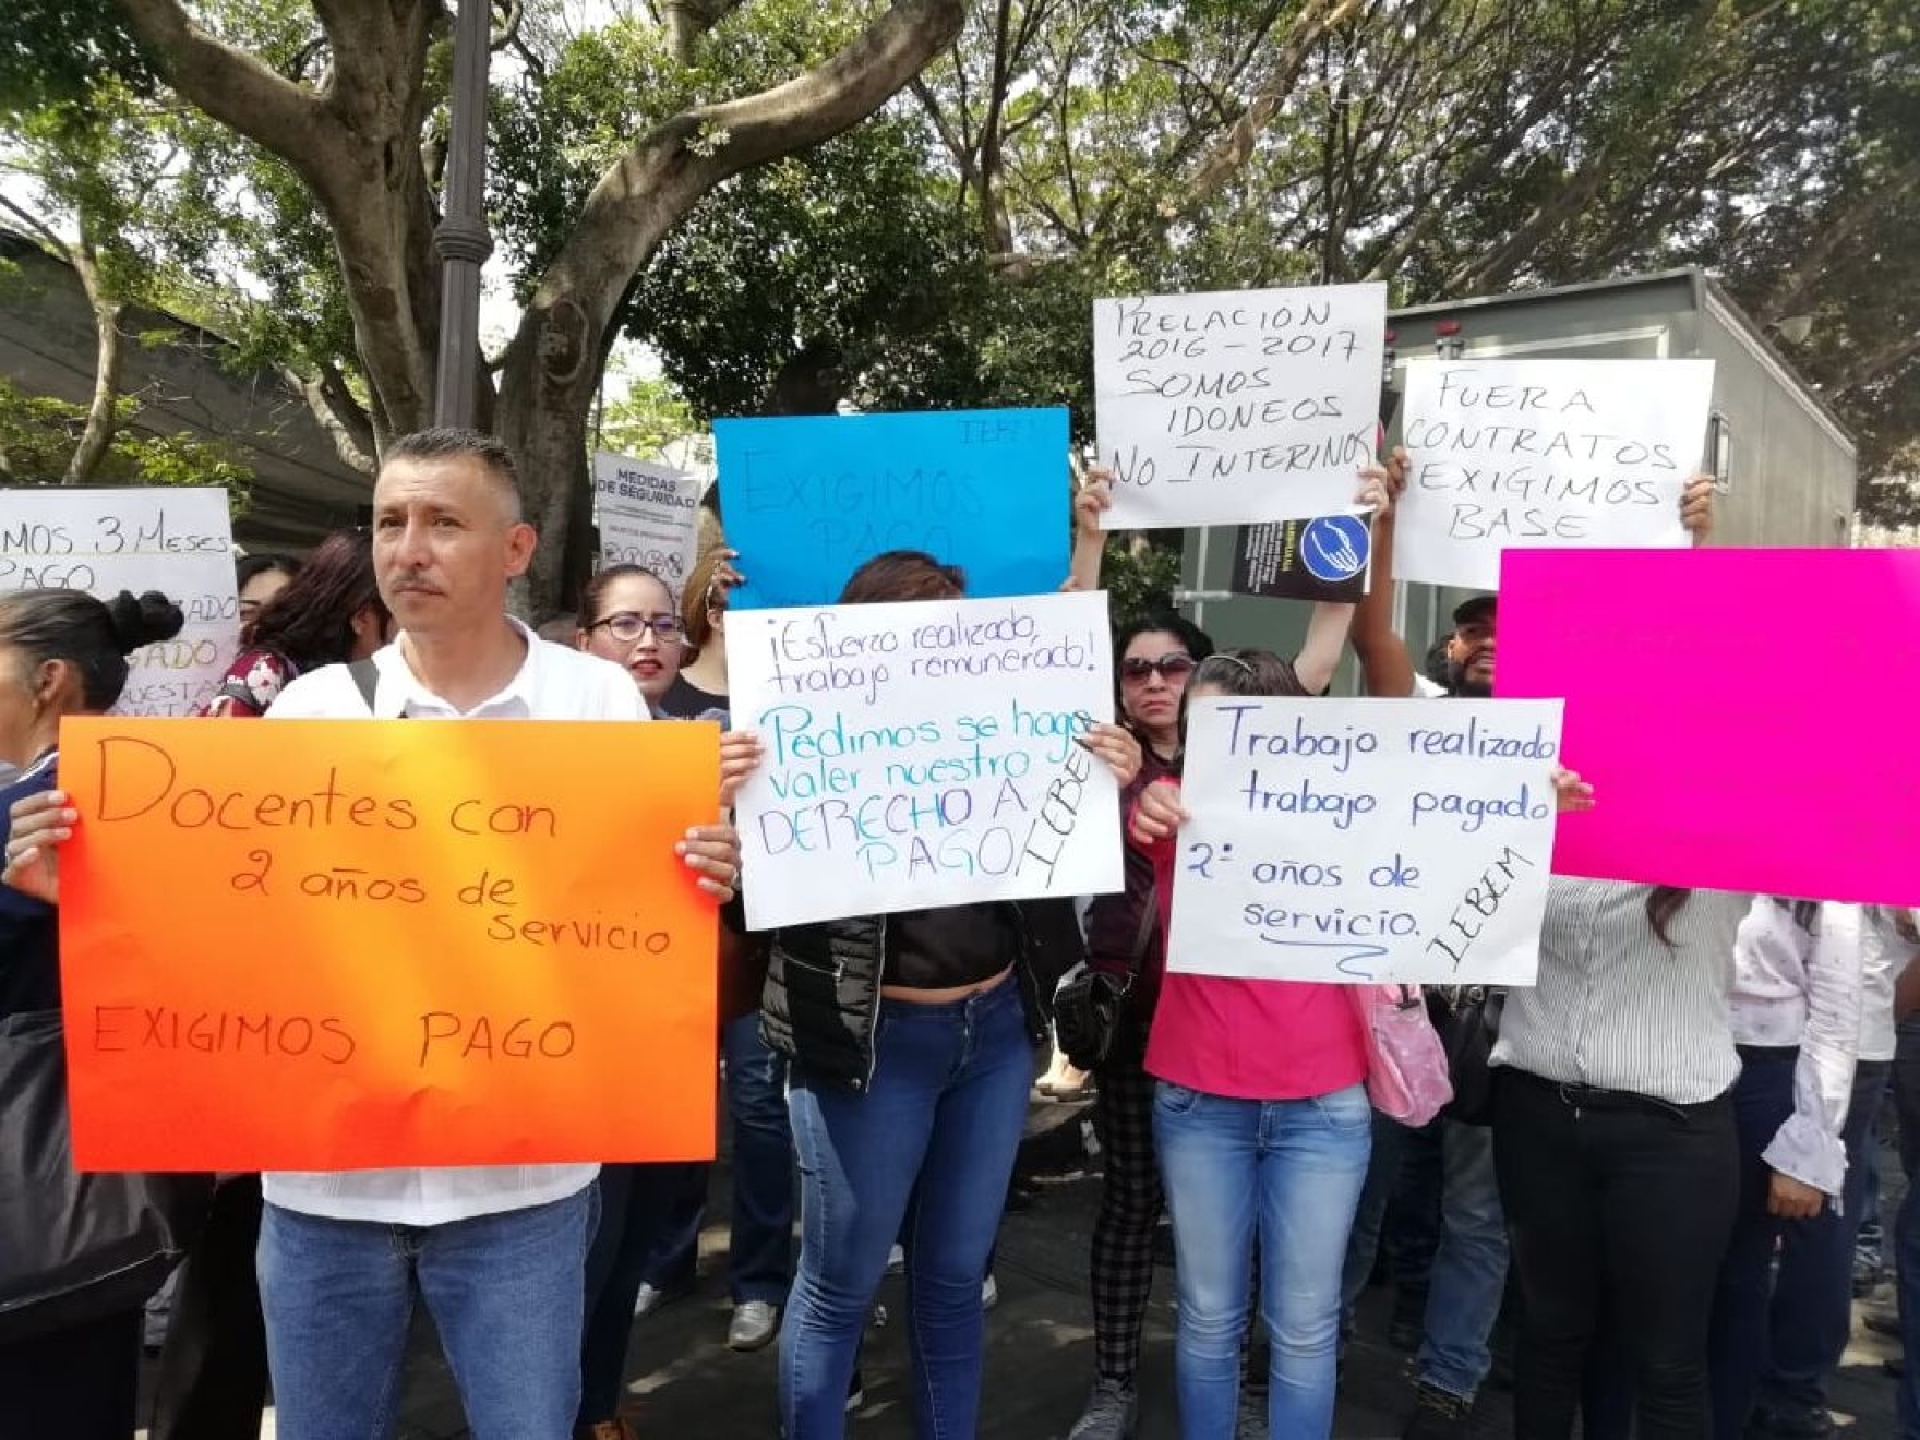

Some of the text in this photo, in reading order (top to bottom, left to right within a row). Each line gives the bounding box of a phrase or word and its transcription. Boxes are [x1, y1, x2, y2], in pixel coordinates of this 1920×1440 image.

[1119, 336, 1206, 362] 2016
[1262, 330, 1364, 362] 2017
[1120, 368, 1271, 398] SOMOS
[1439, 369, 1596, 413] FUERA
[1167, 396, 1342, 436] IDONEOS
[1109, 422, 1372, 490] NO INTERINOS
[1405, 418, 1678, 470] CONTRATOS
[598, 479, 695, 508] DE SEGURIDAD
[616, 468, 676, 492] MEDIDAS
[742, 448, 985, 517] EXIGIMOS
[1419, 462, 1660, 505] EXIGIMOS
[95, 516, 124, 555] 3
[1449, 503, 1588, 539] BASE
[768, 629, 1096, 706] trabajo remunerado!
[759, 705, 940, 766] Pedimos
[957, 713, 998, 743] se
[1216, 705, 1556, 772] Trabajo realizado
[96, 736, 556, 837] Docentes con
[769, 742, 1030, 800] valer nuestro
[758, 777, 1028, 856] DERECHO A
[1240, 769, 1549, 833] trabajo pagado
[230, 849, 517, 907] 2 años de
[856, 827, 1014, 882] PAGO
[1252, 859, 1343, 888] años
[1369, 853, 1421, 888] de
[487, 911, 672, 956] servicio
[1425, 846, 1535, 973] IEBEM
[94, 1004, 576, 1068] EXIGIMOS PAGO
